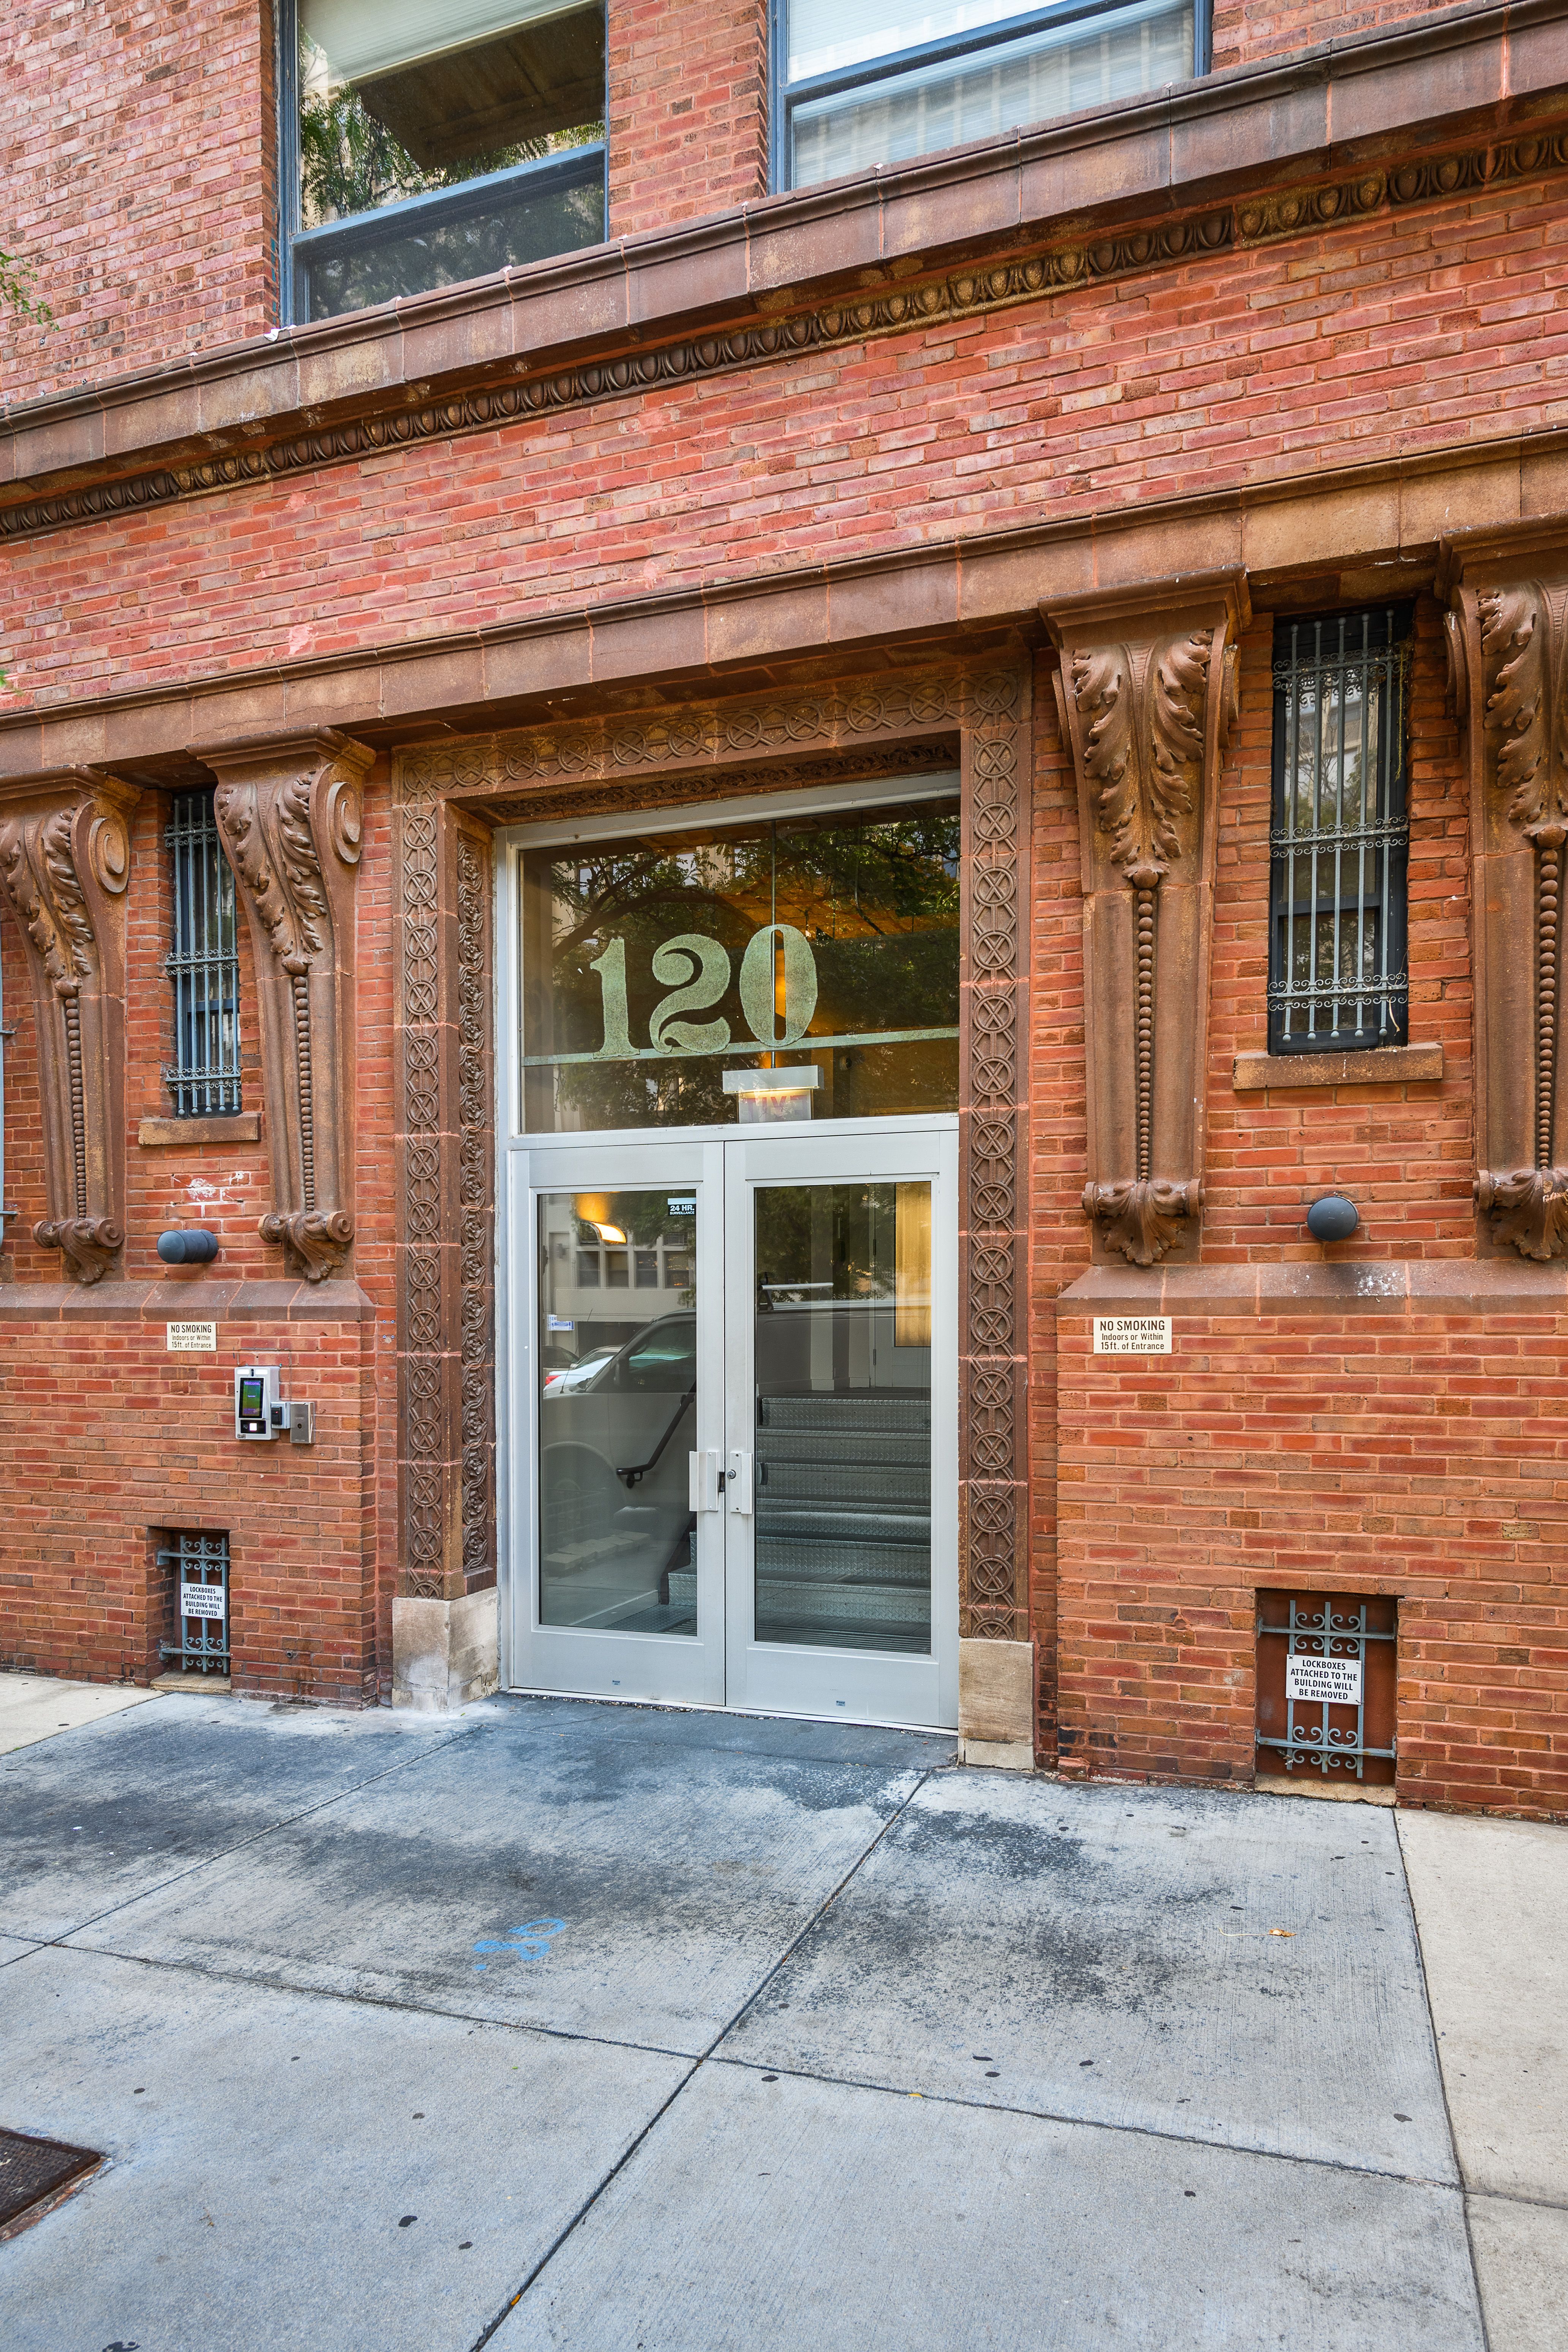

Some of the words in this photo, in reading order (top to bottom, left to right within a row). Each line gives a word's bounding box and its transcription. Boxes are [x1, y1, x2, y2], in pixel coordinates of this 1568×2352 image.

[590, 924, 818, 1058] 120
[1100, 1321, 1113, 1331] NO
[1117, 1320, 1165, 1331] SMOKING
[1302, 1660, 1346, 1670] LOCKBOXES
[1290, 1668, 1329, 1678] ATTACHED
[1295, 1678, 1331, 1688] BUILDING
[1334, 1682, 1353, 1690] WILL
[1311, 1690, 1348, 1699] REMOVED
